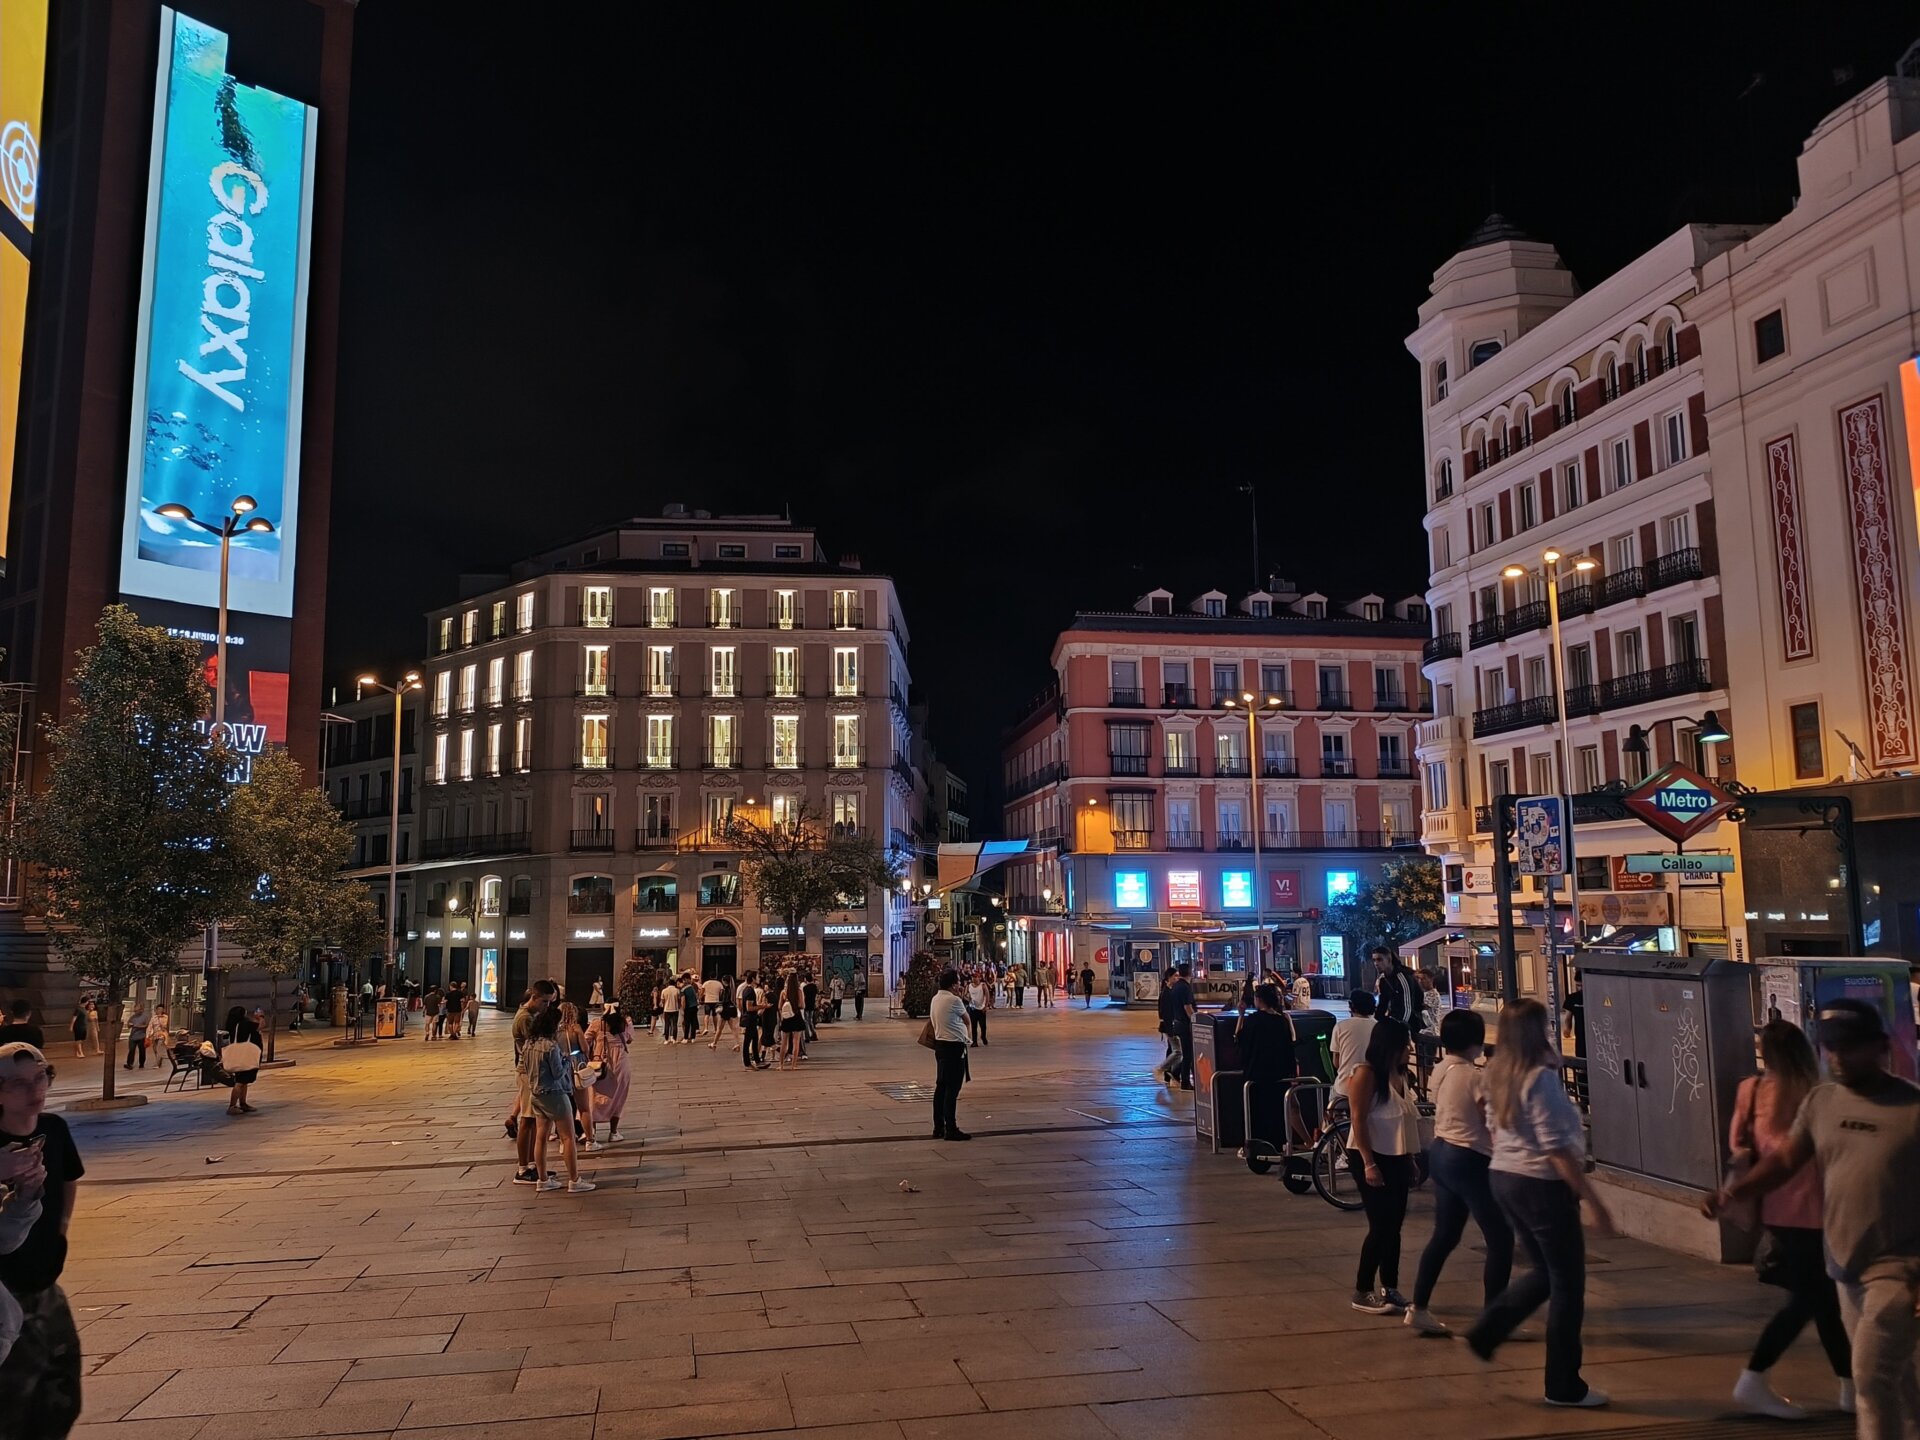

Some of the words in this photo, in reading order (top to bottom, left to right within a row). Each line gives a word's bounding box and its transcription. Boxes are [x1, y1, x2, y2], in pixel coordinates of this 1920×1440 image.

[178, 159, 270, 413] Galaxy
[1660, 791, 1708, 808] Metro
[1661, 858, 1703, 870] Callao
[823, 925, 868, 935] RODILLA
